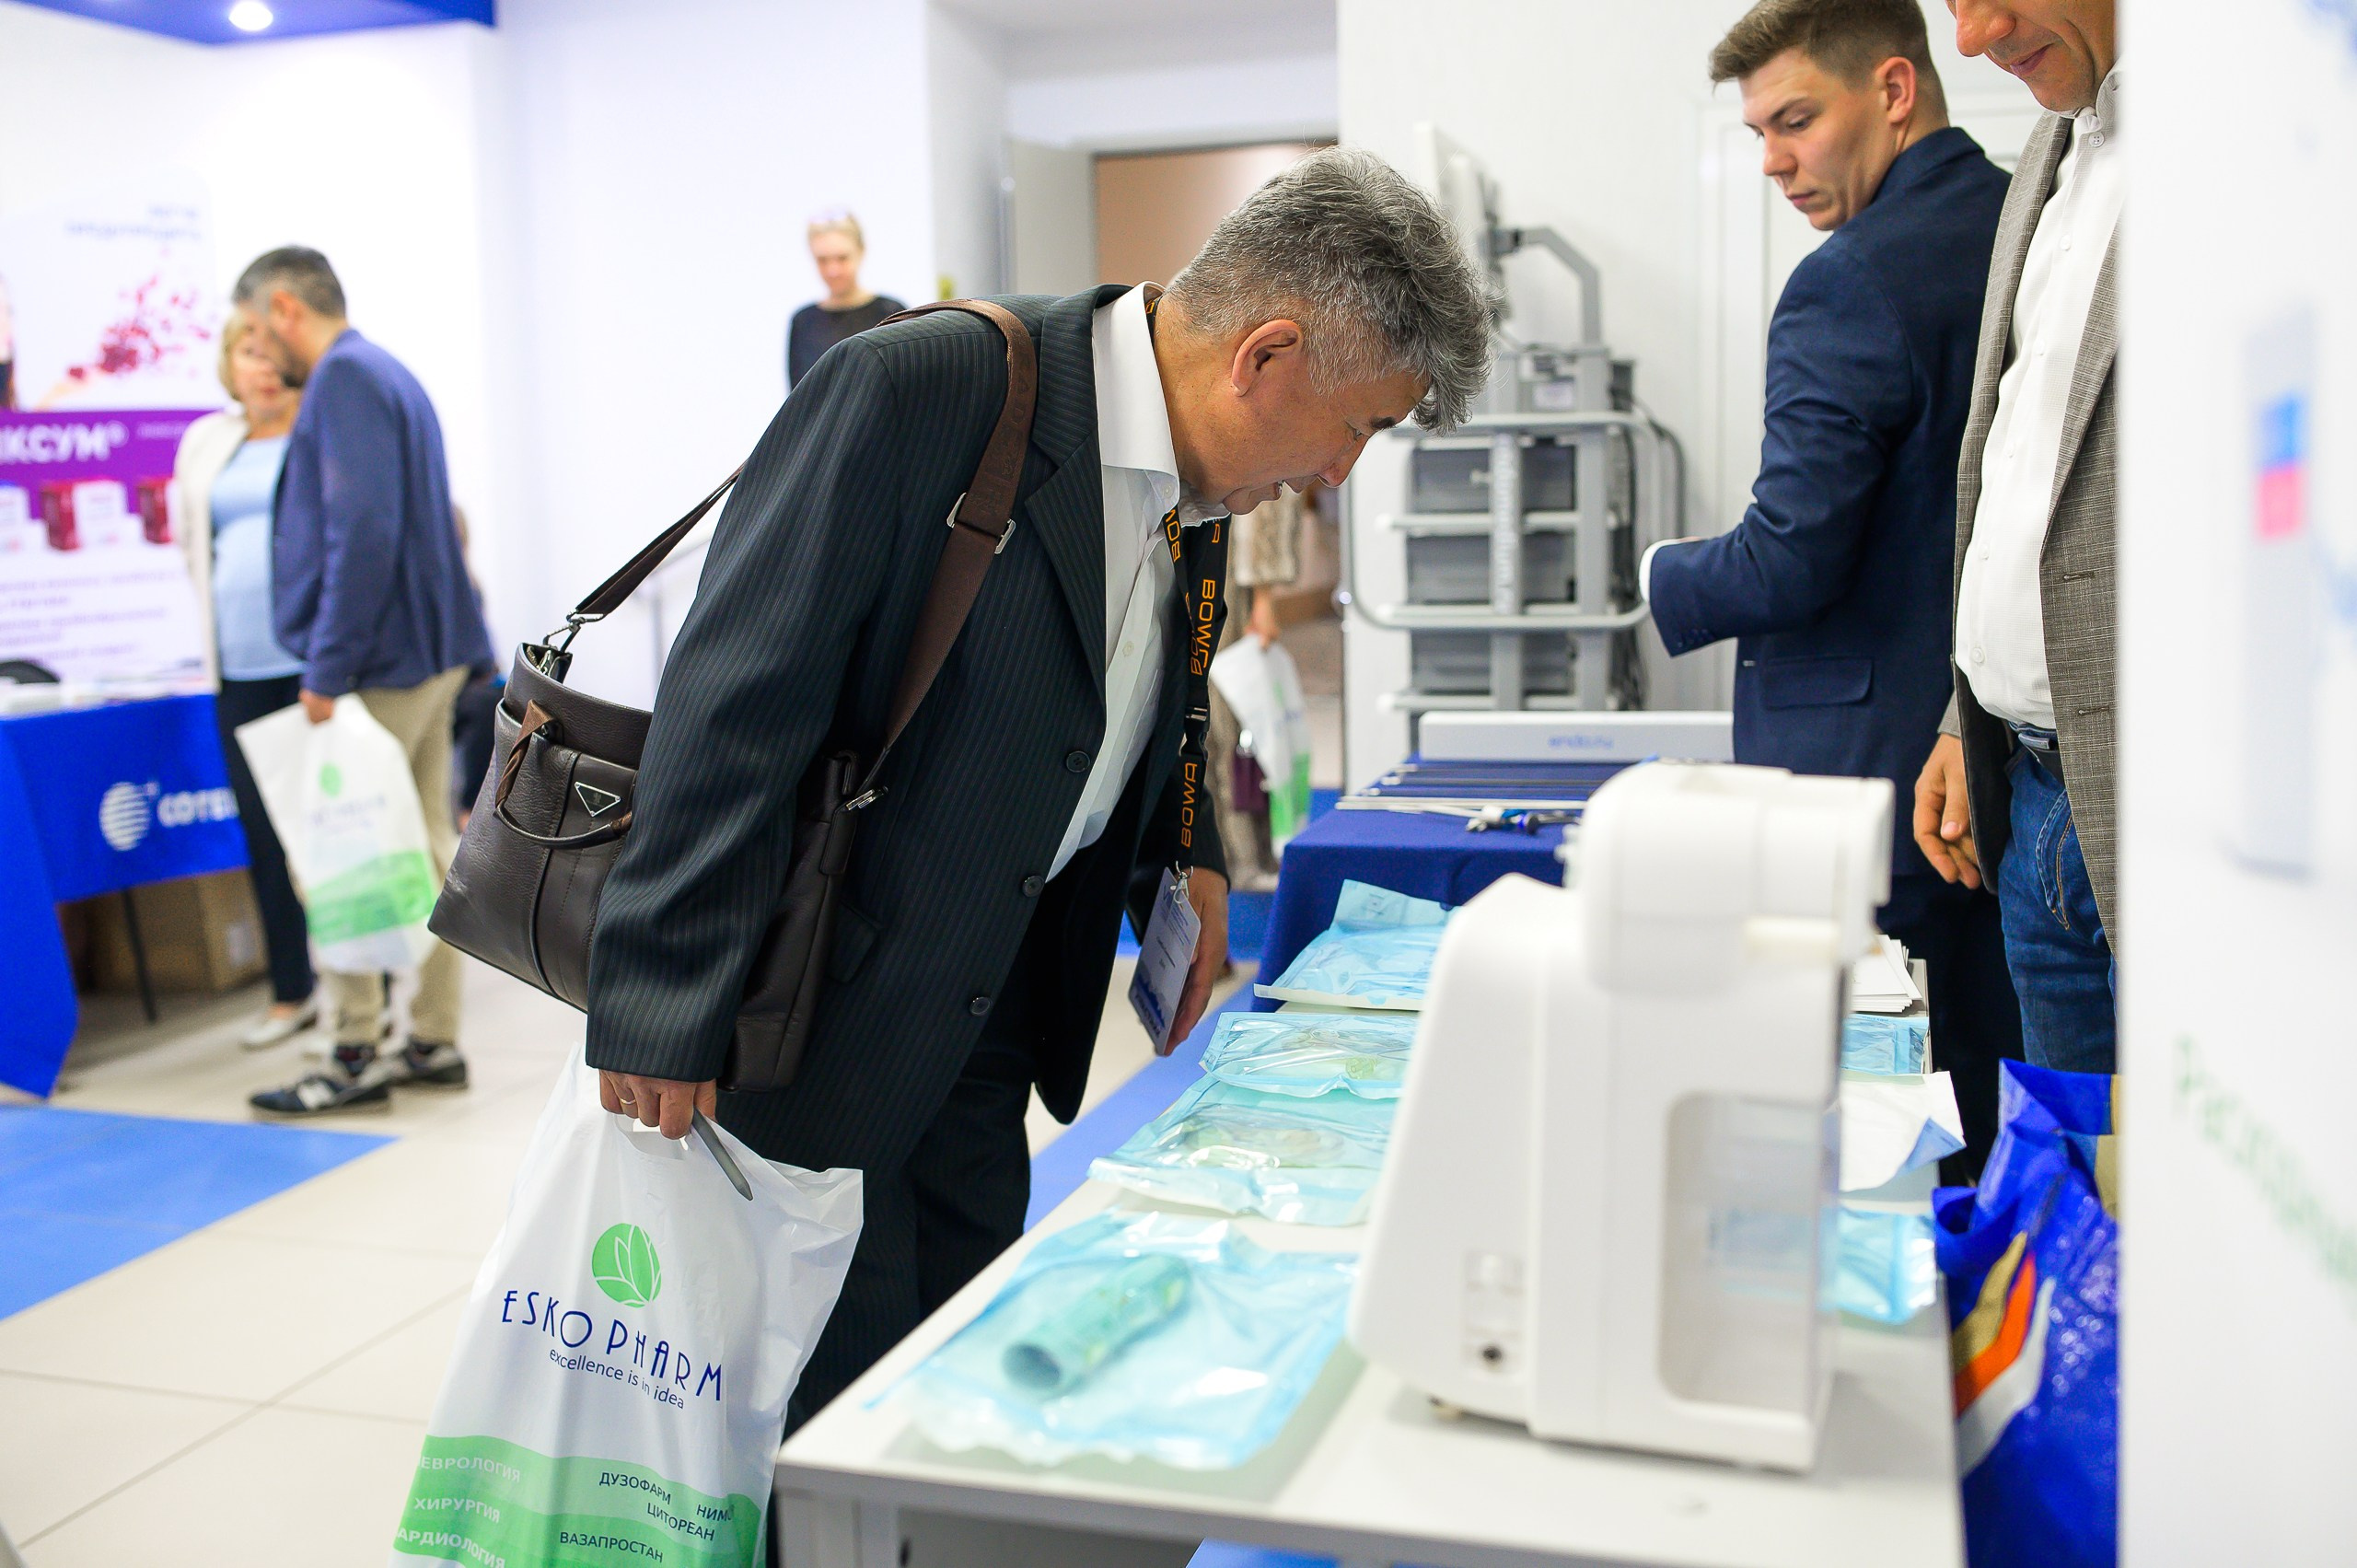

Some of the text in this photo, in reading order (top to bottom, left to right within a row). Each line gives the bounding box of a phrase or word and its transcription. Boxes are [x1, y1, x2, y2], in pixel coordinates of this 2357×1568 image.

[1180, 761, 1198, 848] BOWA
[502, 1290, 722, 1401] ESKO PHARM
[550, 1347, 684, 1410] excellence is in idea
[421, 1456, 521, 1482] ЕВРОЛОГИЯ
[599, 1471, 671, 1504] ДУЗОФАРМ
[414, 1497, 500, 1523] ХИРУРГИЯ
[647, 1503, 715, 1541] ЦИТОРЕАН
[560, 1531, 663, 1563] ВАЗАПРОСТАН
